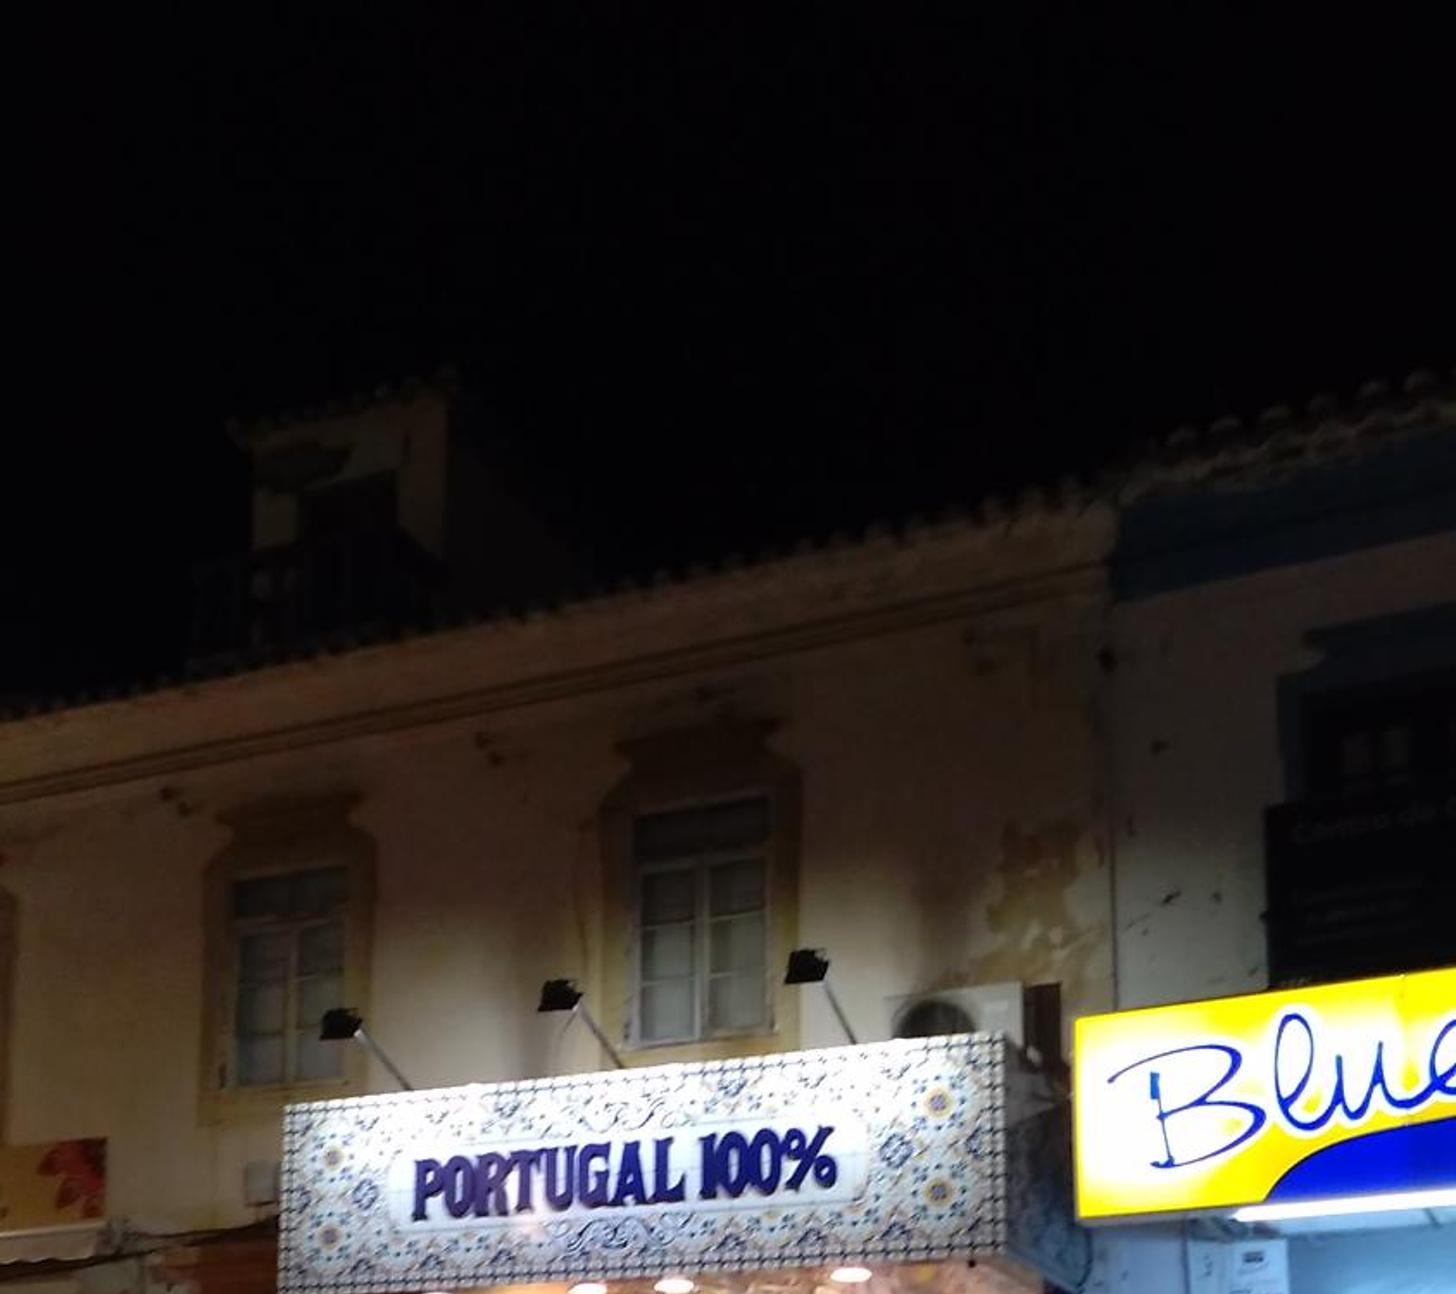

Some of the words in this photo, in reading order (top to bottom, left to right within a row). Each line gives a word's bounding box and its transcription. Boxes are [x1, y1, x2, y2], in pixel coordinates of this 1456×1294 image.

[1107, 1013, 1456, 1169] Blue
[411, 1137, 686, 1222] PORTUGAL
[697, 1126, 838, 1200] 100%
